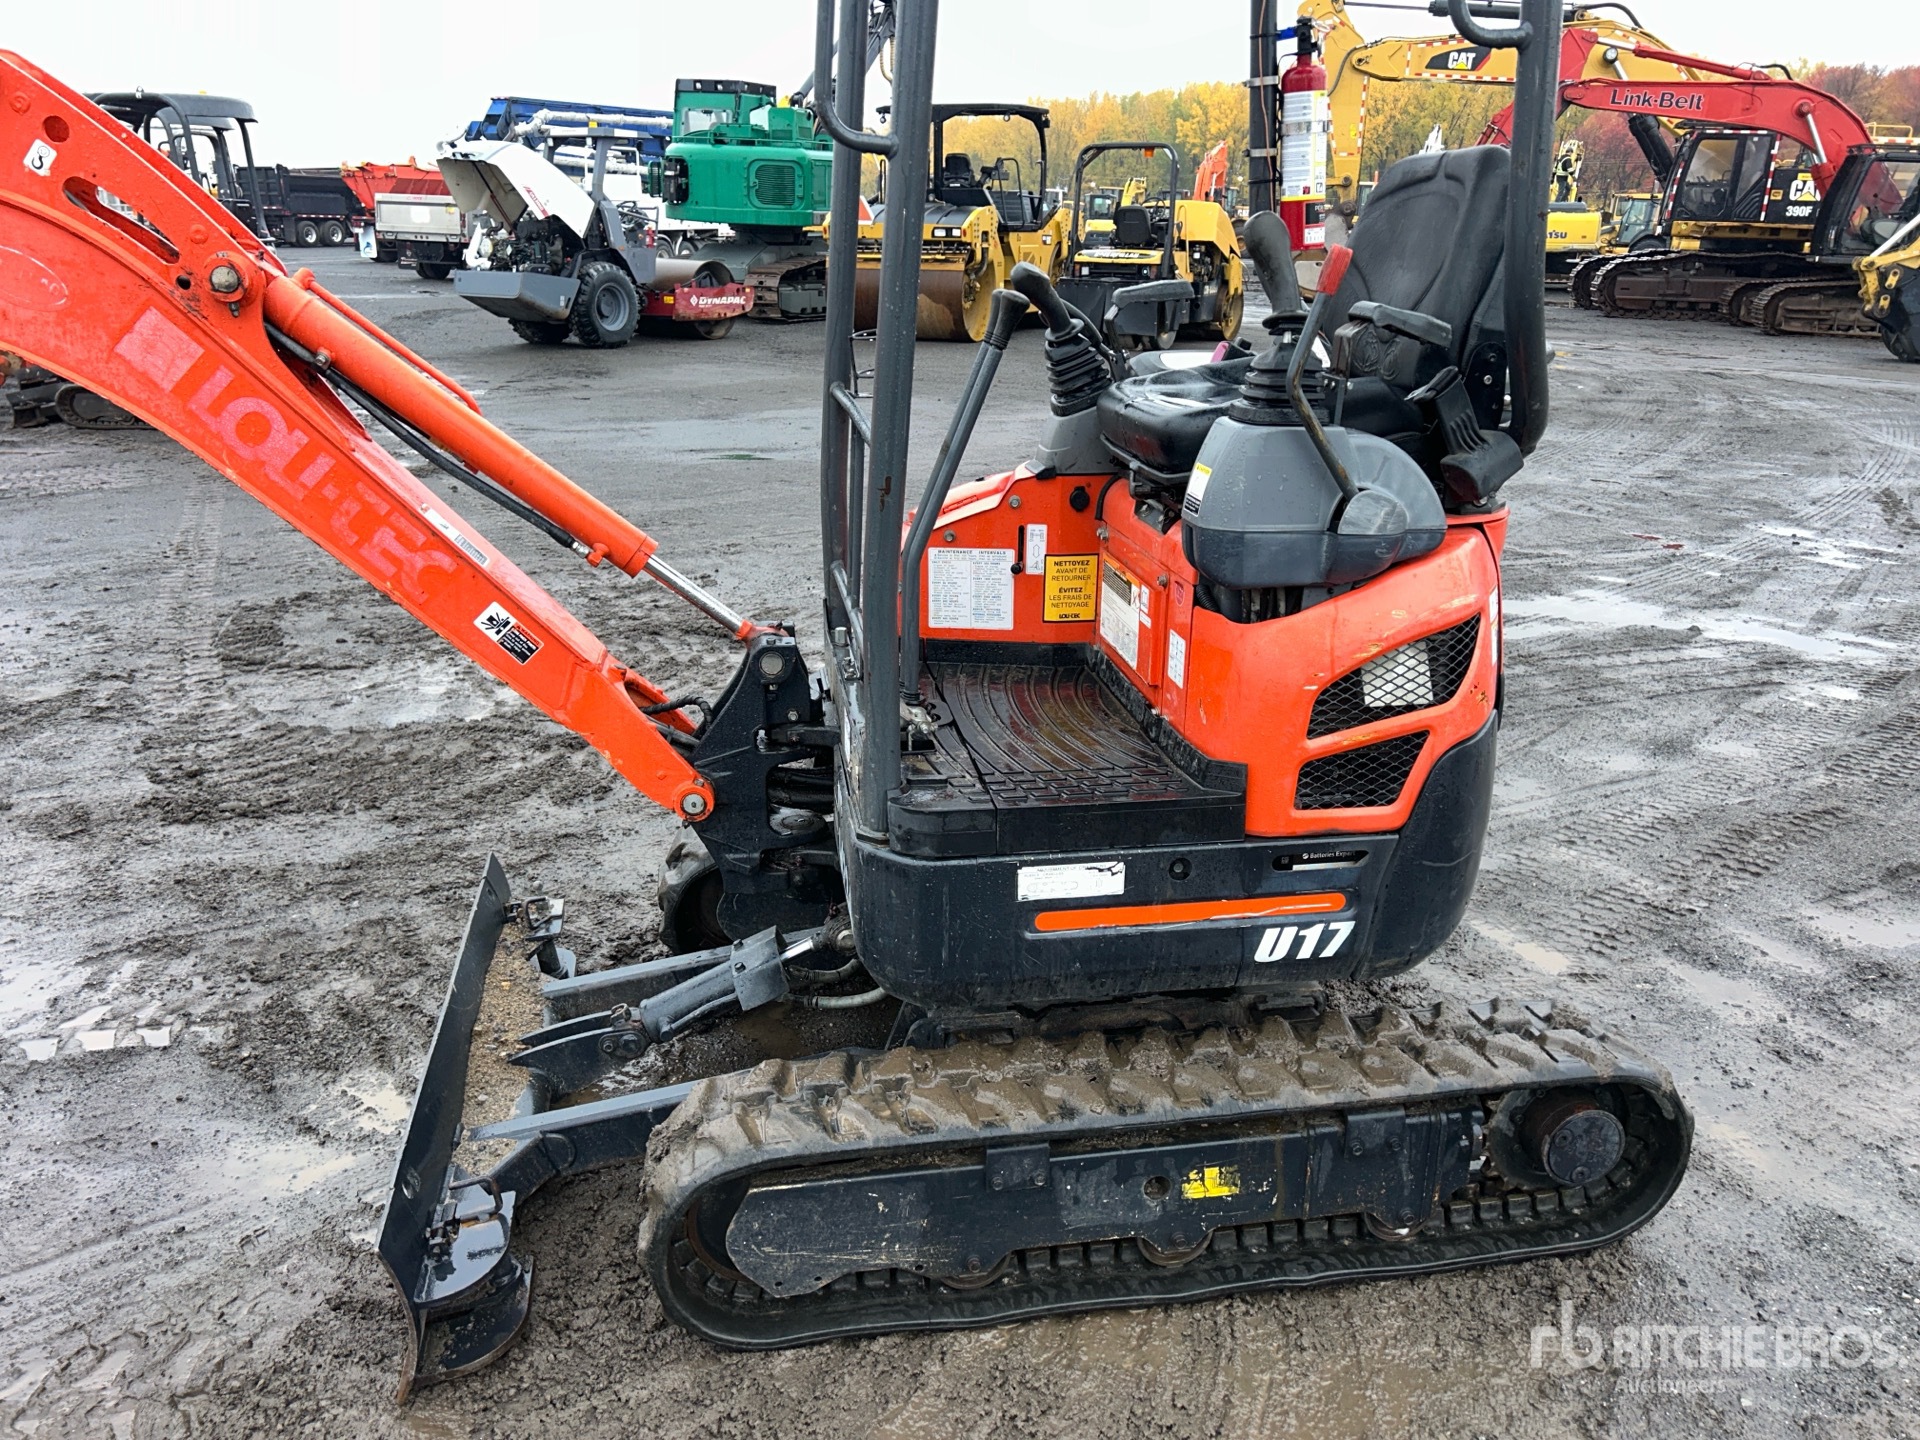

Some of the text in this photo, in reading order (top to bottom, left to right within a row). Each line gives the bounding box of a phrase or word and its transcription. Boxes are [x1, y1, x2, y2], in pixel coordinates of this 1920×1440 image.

[1448, 51, 1476, 70] CAT
[1610, 89, 1703, 110] Link-Belt
[1785, 205, 1813, 217] 390F
[698, 296, 746, 304] DYNAPAC
[1254, 921, 1356, 962] U17
